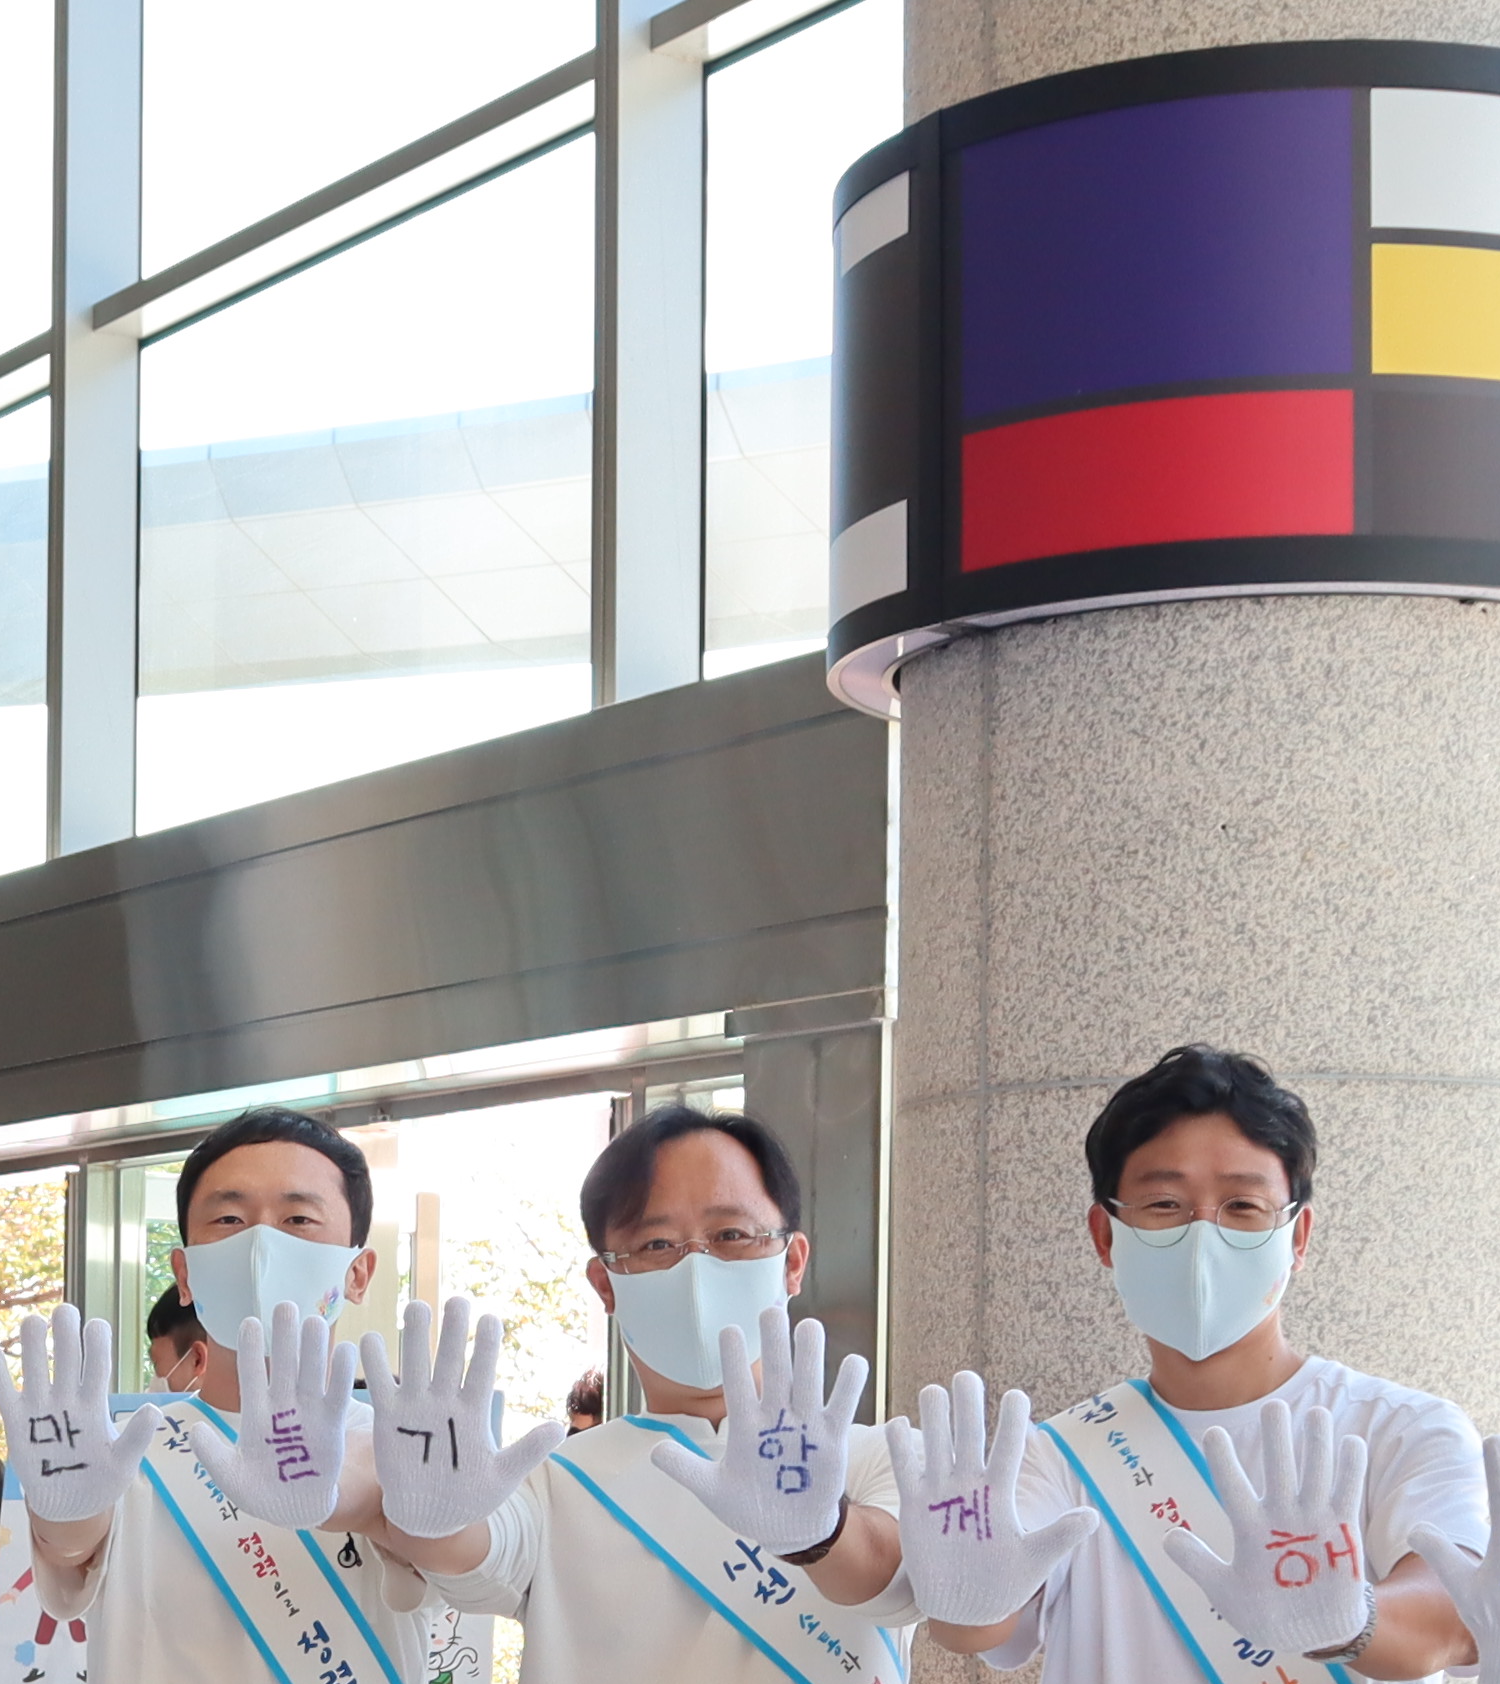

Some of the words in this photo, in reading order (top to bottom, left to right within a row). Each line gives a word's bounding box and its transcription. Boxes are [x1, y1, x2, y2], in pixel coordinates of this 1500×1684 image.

[1106, 1429, 1155, 1487] 소통과
[237, 1531, 300, 1617] 협력으로
[723, 1538, 797, 1606] 사천
[798, 1613, 862, 1674] 소통과
